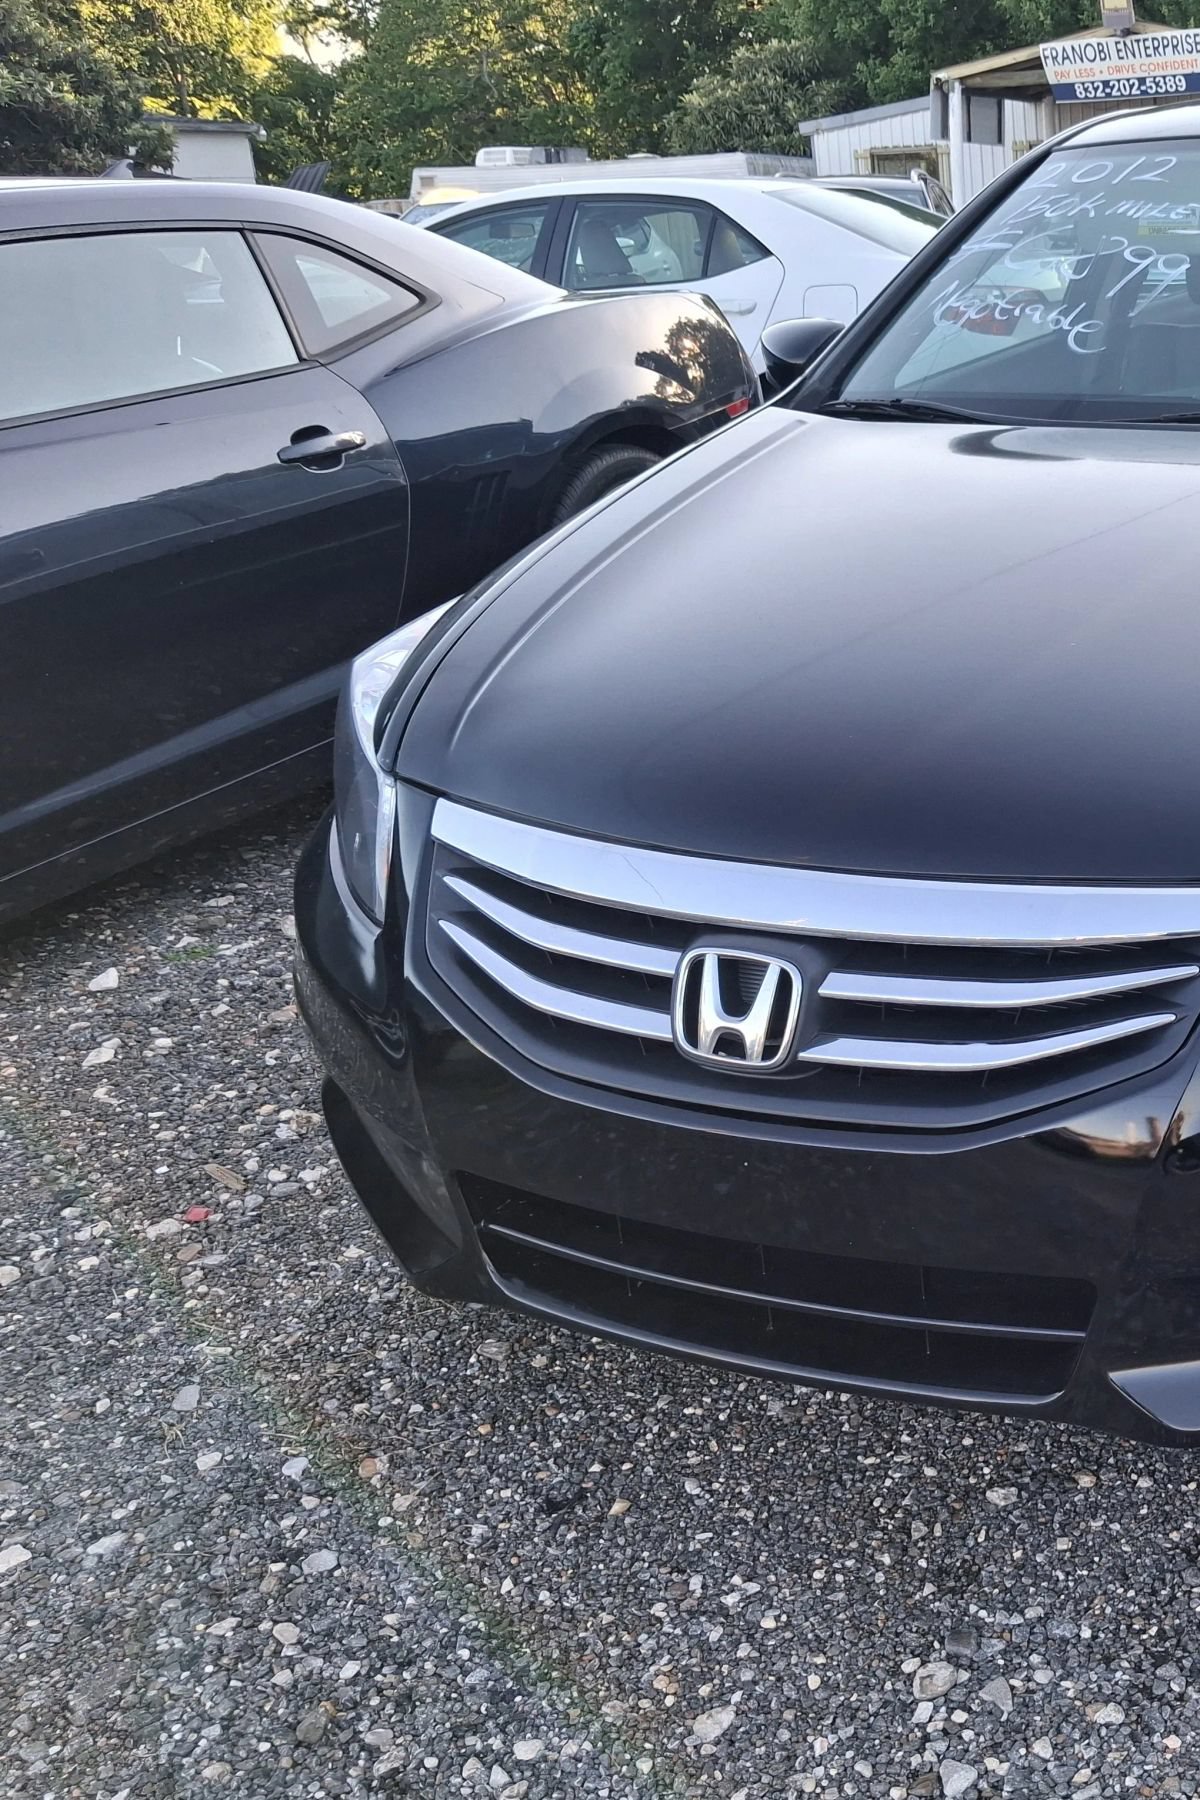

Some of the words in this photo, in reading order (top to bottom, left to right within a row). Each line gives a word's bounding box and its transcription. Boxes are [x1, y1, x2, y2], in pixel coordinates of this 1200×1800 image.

[1042, 41, 1112, 67] FRANOBI
[1054, 69, 1071, 80] PAY
[1074, 67, 1096, 79] LESS
[1107, 64, 1137, 76] DRIVE
[1139, 58, 1199, 73] CONFIDENT
[1074, 74, 1187, 99] 832-202-5389
[1020, 156, 1177, 191] 2012
